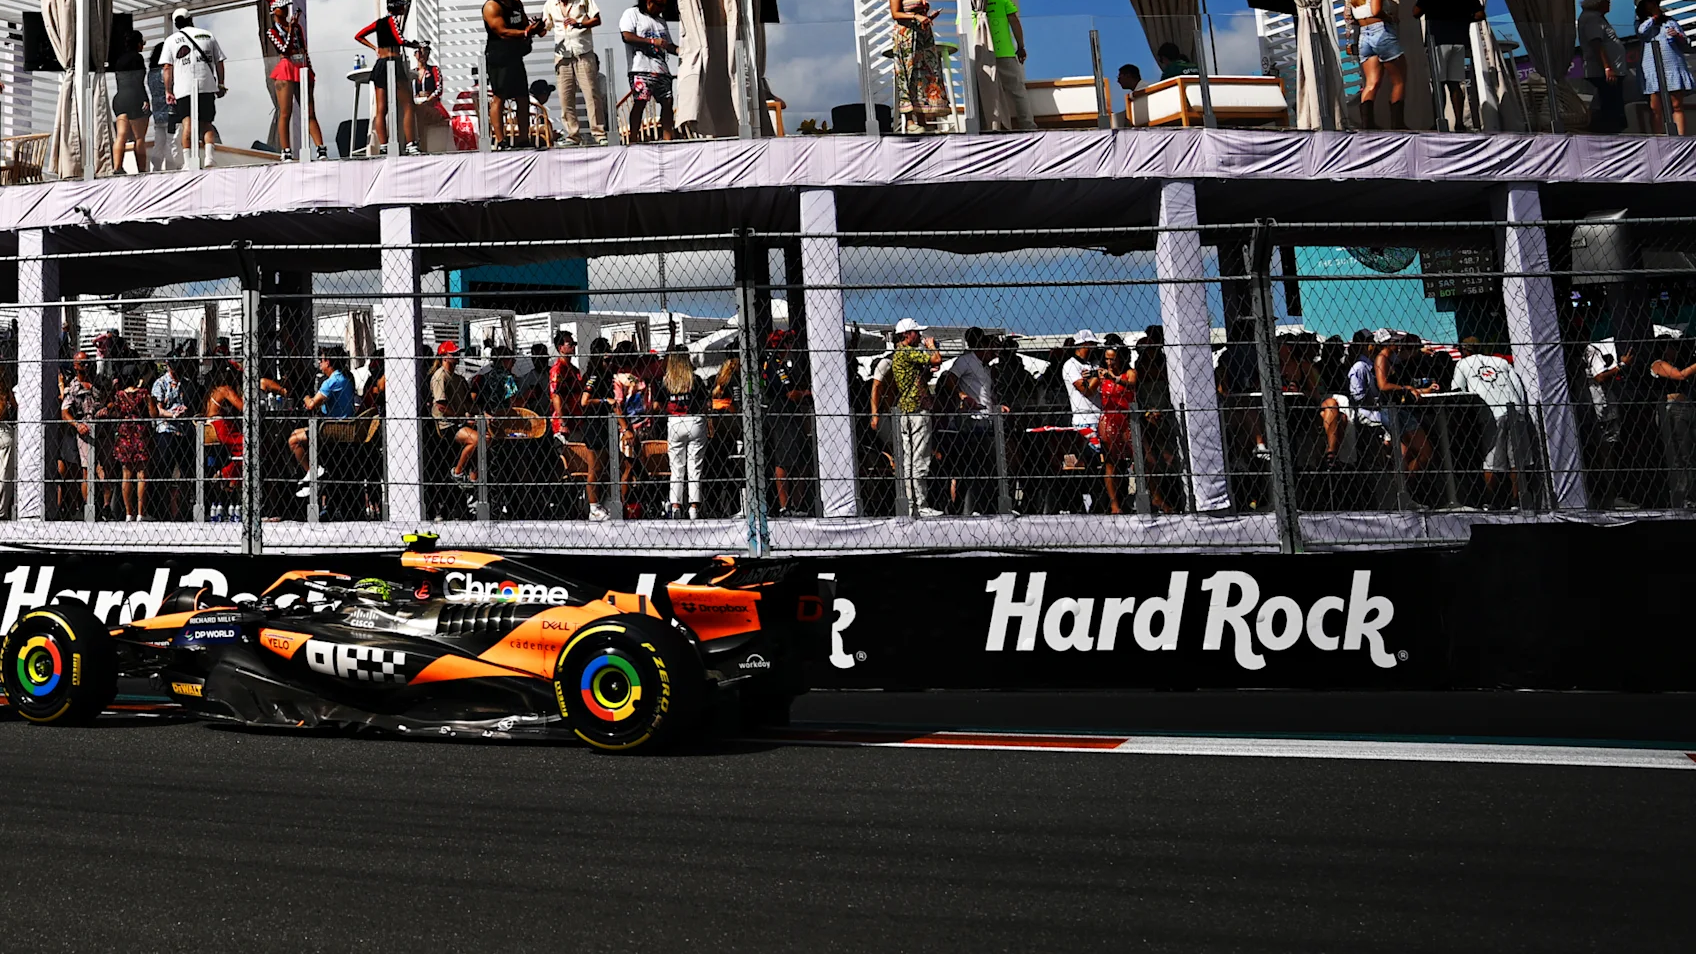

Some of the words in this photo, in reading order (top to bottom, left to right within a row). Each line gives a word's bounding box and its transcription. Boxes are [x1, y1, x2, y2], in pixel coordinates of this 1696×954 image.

[422, 555, 456, 565] VELO
[443, 571, 569, 606] Chrome
[699, 602, 749, 614] Dropbox
[189, 616, 216, 624] RICHARD
[542, 620, 571, 632] DELL
[985, 570, 1189, 652] Hard
[1200, 570, 1397, 670] Rock
[194, 630, 206, 639] DP
[206, 629, 235, 638] WORLD
[266, 638, 290, 650] VELO
[738, 659, 771, 669] workday
[652, 656, 671, 713] ZERO
